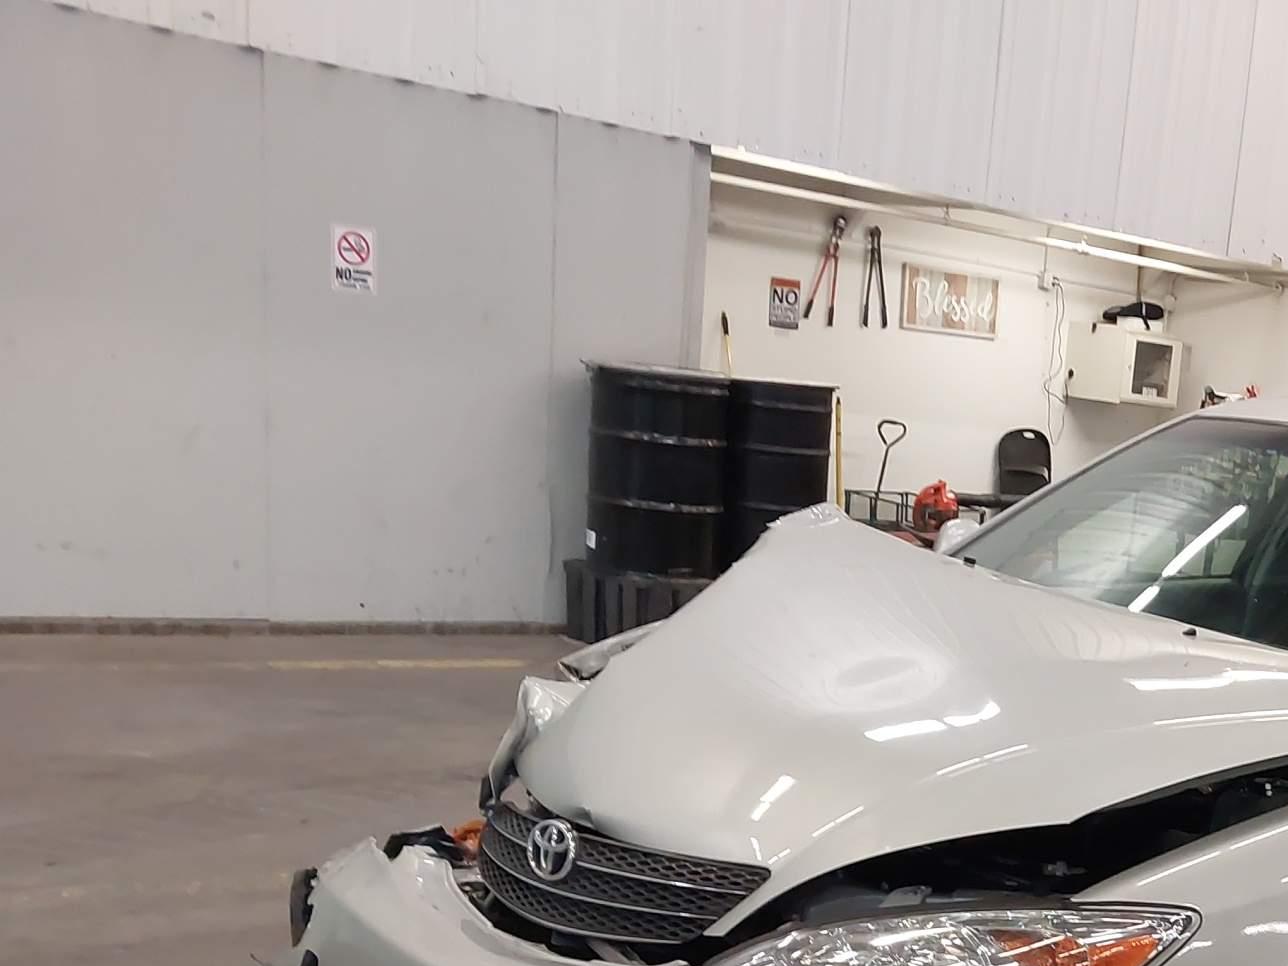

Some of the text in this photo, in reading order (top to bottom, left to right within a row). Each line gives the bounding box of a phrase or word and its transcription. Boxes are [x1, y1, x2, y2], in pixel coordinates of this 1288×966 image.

[335, 266, 352, 281] NO
[772, 287, 798, 306] NO
[912, 276, 993, 322] Blessed
